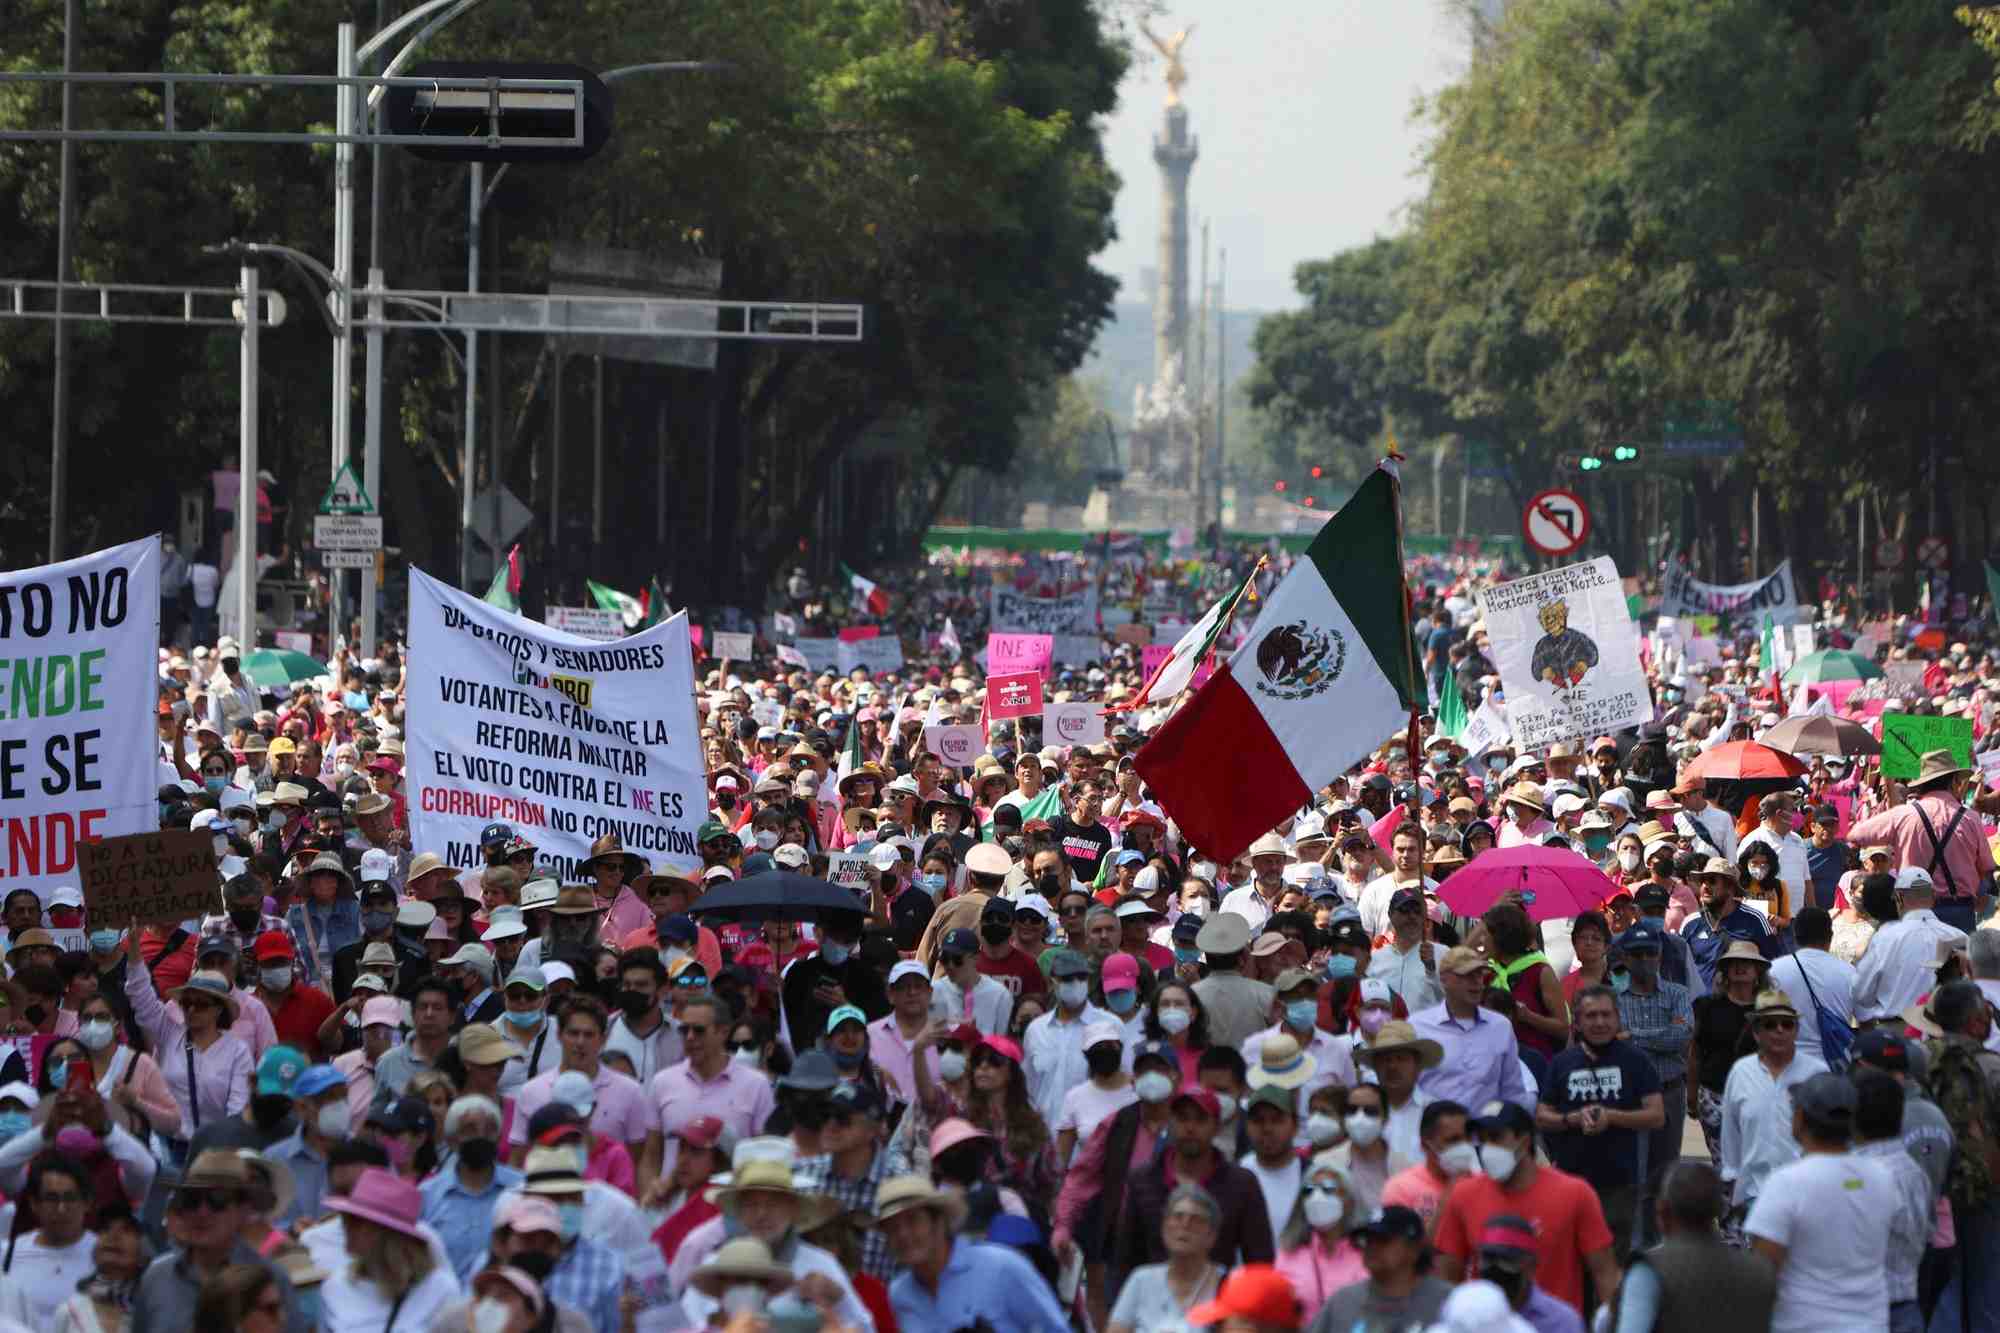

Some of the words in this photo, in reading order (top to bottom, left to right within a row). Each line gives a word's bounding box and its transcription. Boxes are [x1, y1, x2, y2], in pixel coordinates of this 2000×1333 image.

[1484, 579, 1538, 601] Mientras
[1582, 564, 1597, 576] en
[1486, 590, 1550, 614] Mexicorea
[1552, 581, 1568, 596] del
[68, 566, 129, 635] NO
[536, 642, 548, 664] Y
[551, 644, 665, 673] SENADORES
[996, 640, 1025, 658] INE
[440, 676, 543, 720] VOTANTES
[613, 720, 639, 746] DE
[644, 719, 668, 746] LA
[1515, 712, 1545, 725] Kim
[1520, 718, 1564, 734] decide
[1573, 709, 1600, 723] que
[1582, 708, 1635, 728] decidir
[41, 729, 102, 796] SE
[476, 721, 572, 761] REFORMA
[578, 740, 647, 777] MILITAR
[435, 751, 459, 778] EL
[463, 755, 514, 787] VOTO
[519, 767, 598, 803] CONTRA
[604, 780, 628, 808] EL
[660, 791, 684, 819] ES
[421, 786, 547, 828] CORRUPCIÓN
[551, 808, 578, 833] NO
[87, 851, 215, 886] DICTADURA
[87, 890, 221, 924] DEMOCRACIA
